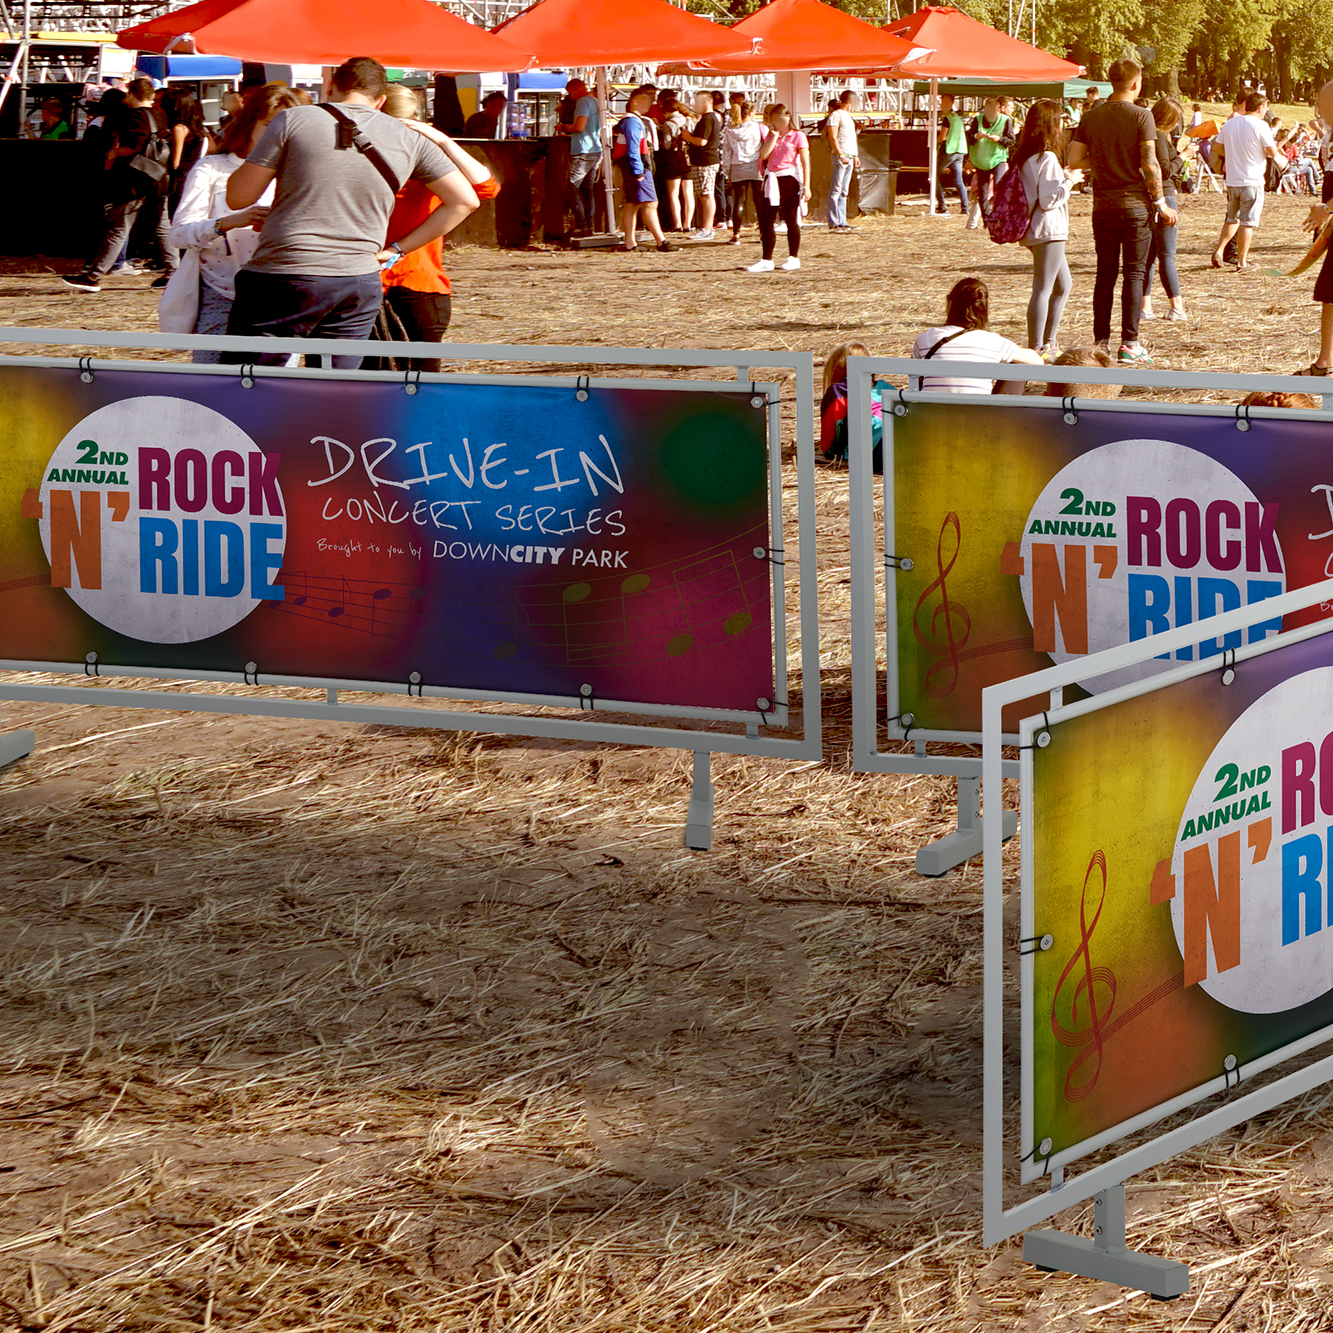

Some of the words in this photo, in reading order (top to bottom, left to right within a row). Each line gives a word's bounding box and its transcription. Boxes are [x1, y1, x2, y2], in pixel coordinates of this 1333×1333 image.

[75, 440, 129, 465] 2ND
[307, 434, 624, 496] DRIVE-IN
[47, 468, 129, 485] ANNUAL
[138, 446, 284, 517] ROCK
[322, 490, 481, 530] CONCERT
[495, 505, 626, 535] SERIES
[1059, 488, 1117, 516] 2ND
[1028, 519, 1117, 538] ANNUAL
[1126, 496, 1283, 573] ROCK
[139, 517, 285, 601] RIDE
[316, 538, 362, 557] Brought
[367, 542, 381, 554] to
[386, 545, 404, 558] you
[407, 542, 422, 560] by
[433, 541, 566, 565] DOWNCITY
[571, 549, 630, 569] PARK
[1128, 573, 1283, 661] RIDE
[1213, 763, 1272, 803] 2ND
[1180, 790, 1272, 841] ANNUAL
